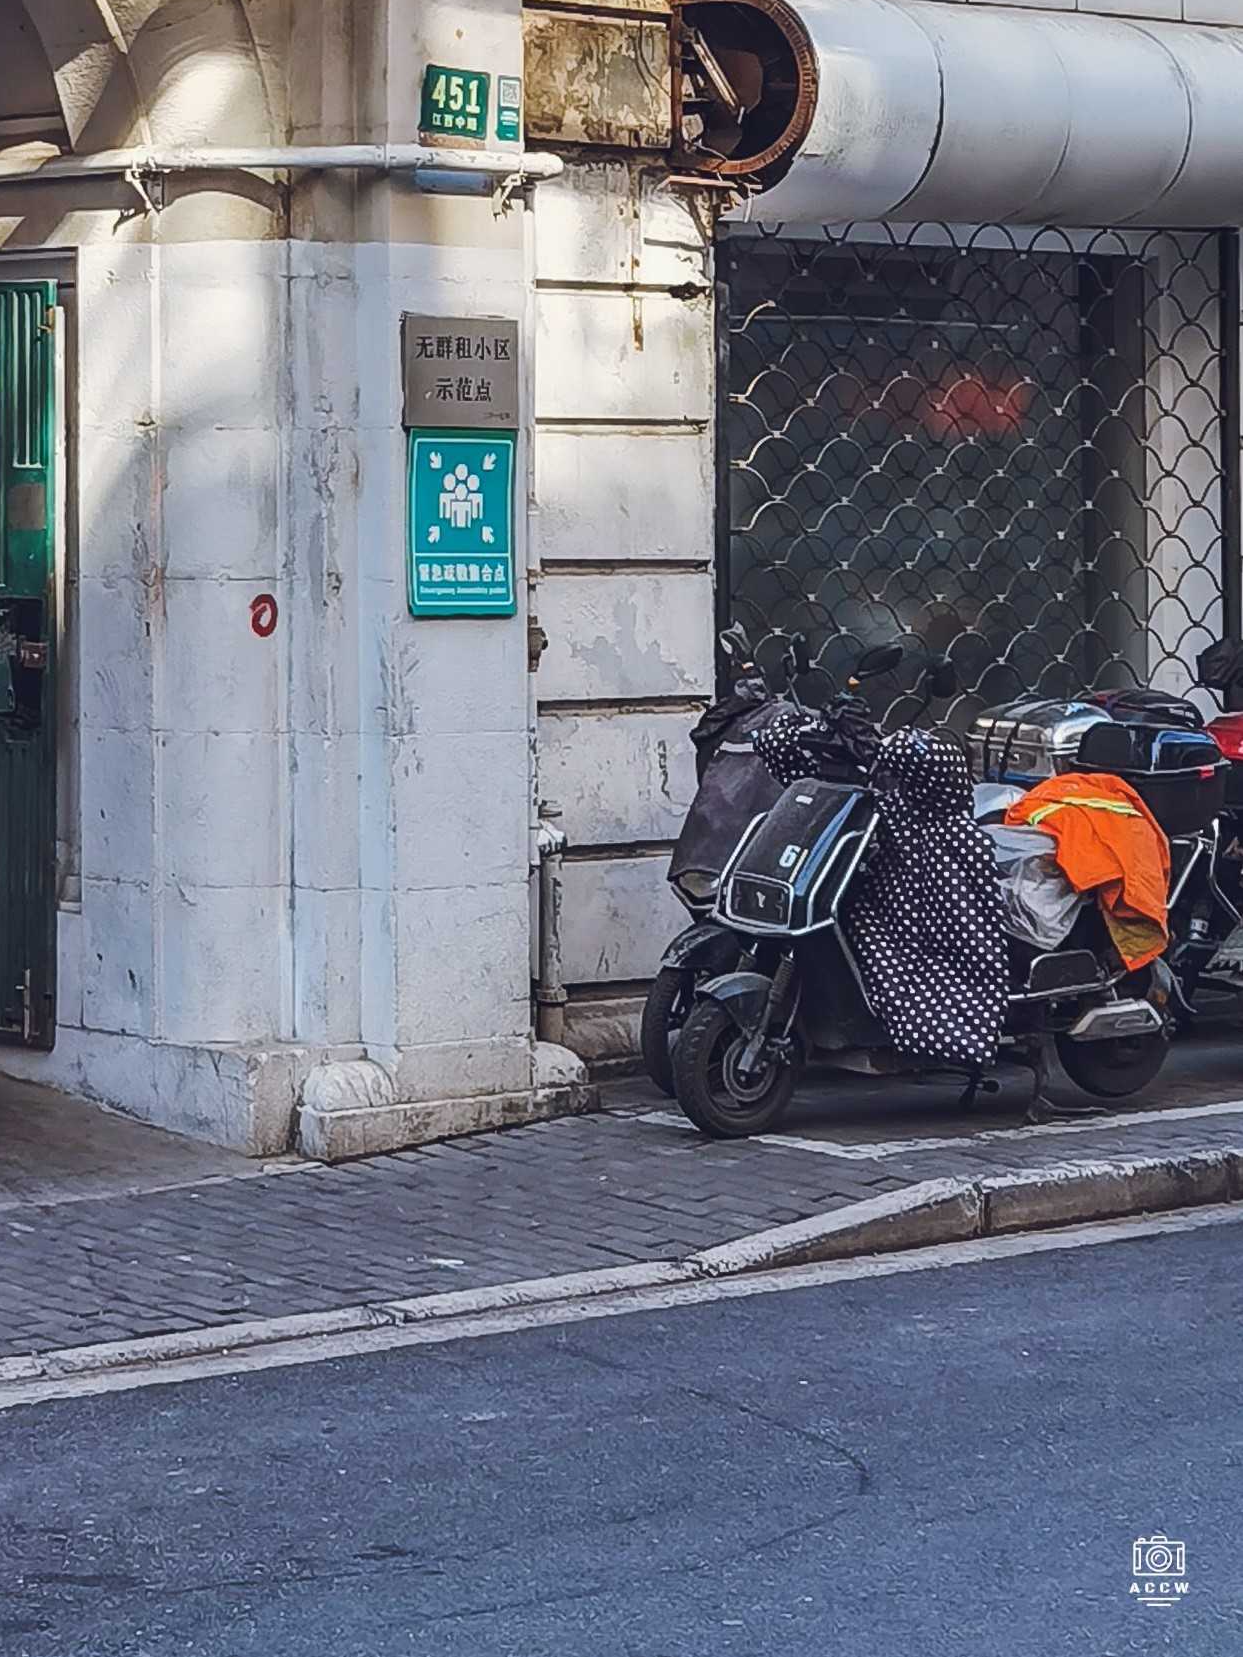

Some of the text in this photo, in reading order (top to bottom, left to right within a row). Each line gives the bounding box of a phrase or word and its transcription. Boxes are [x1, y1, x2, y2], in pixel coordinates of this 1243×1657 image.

[431, 74, 481, 114] 451
[415, 335, 510, 360] 无群租小区
[435, 377, 492, 402] 示范点
